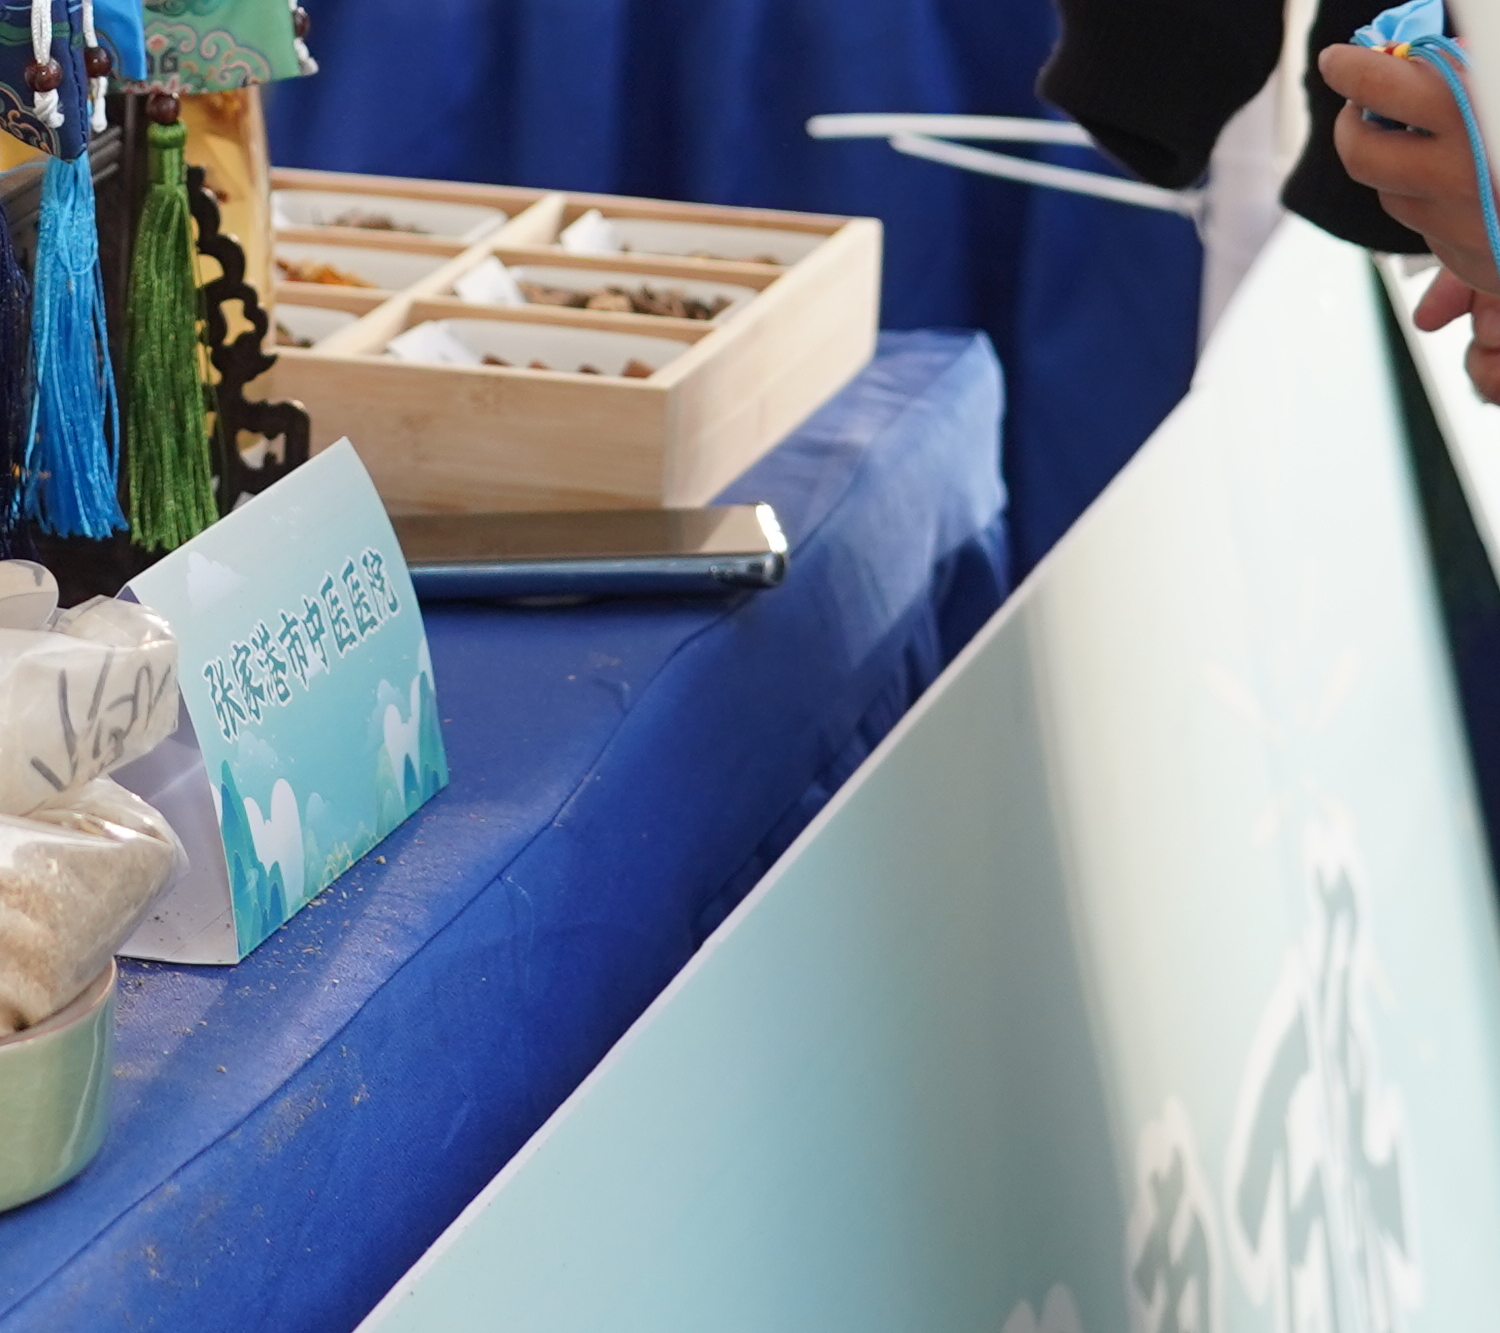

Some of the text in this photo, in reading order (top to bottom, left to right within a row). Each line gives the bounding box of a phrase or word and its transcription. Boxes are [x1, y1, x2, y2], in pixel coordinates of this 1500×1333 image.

[202, 547, 401, 742] 张家港市中医医院
